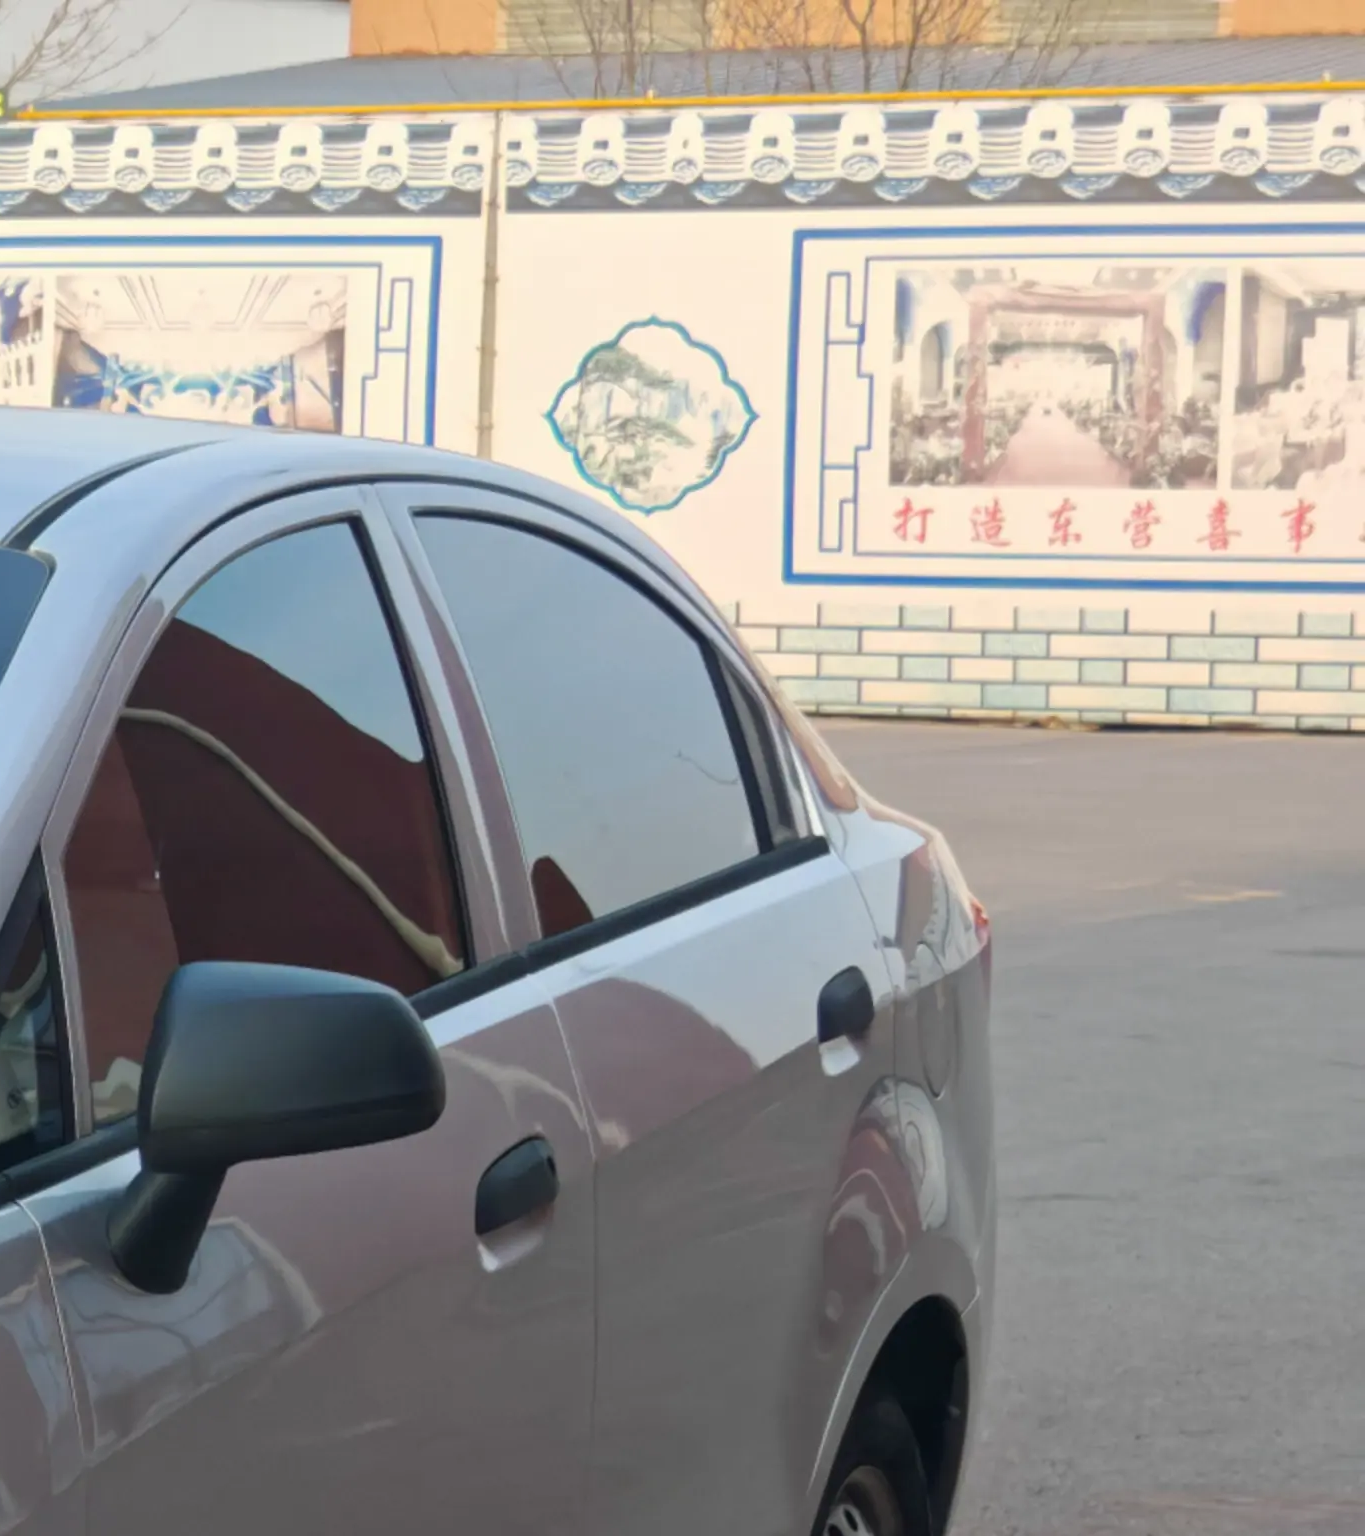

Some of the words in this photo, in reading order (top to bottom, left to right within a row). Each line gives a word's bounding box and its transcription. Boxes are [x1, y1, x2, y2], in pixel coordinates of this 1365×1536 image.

[892, 498, 1365, 554] 打造东营喜事
